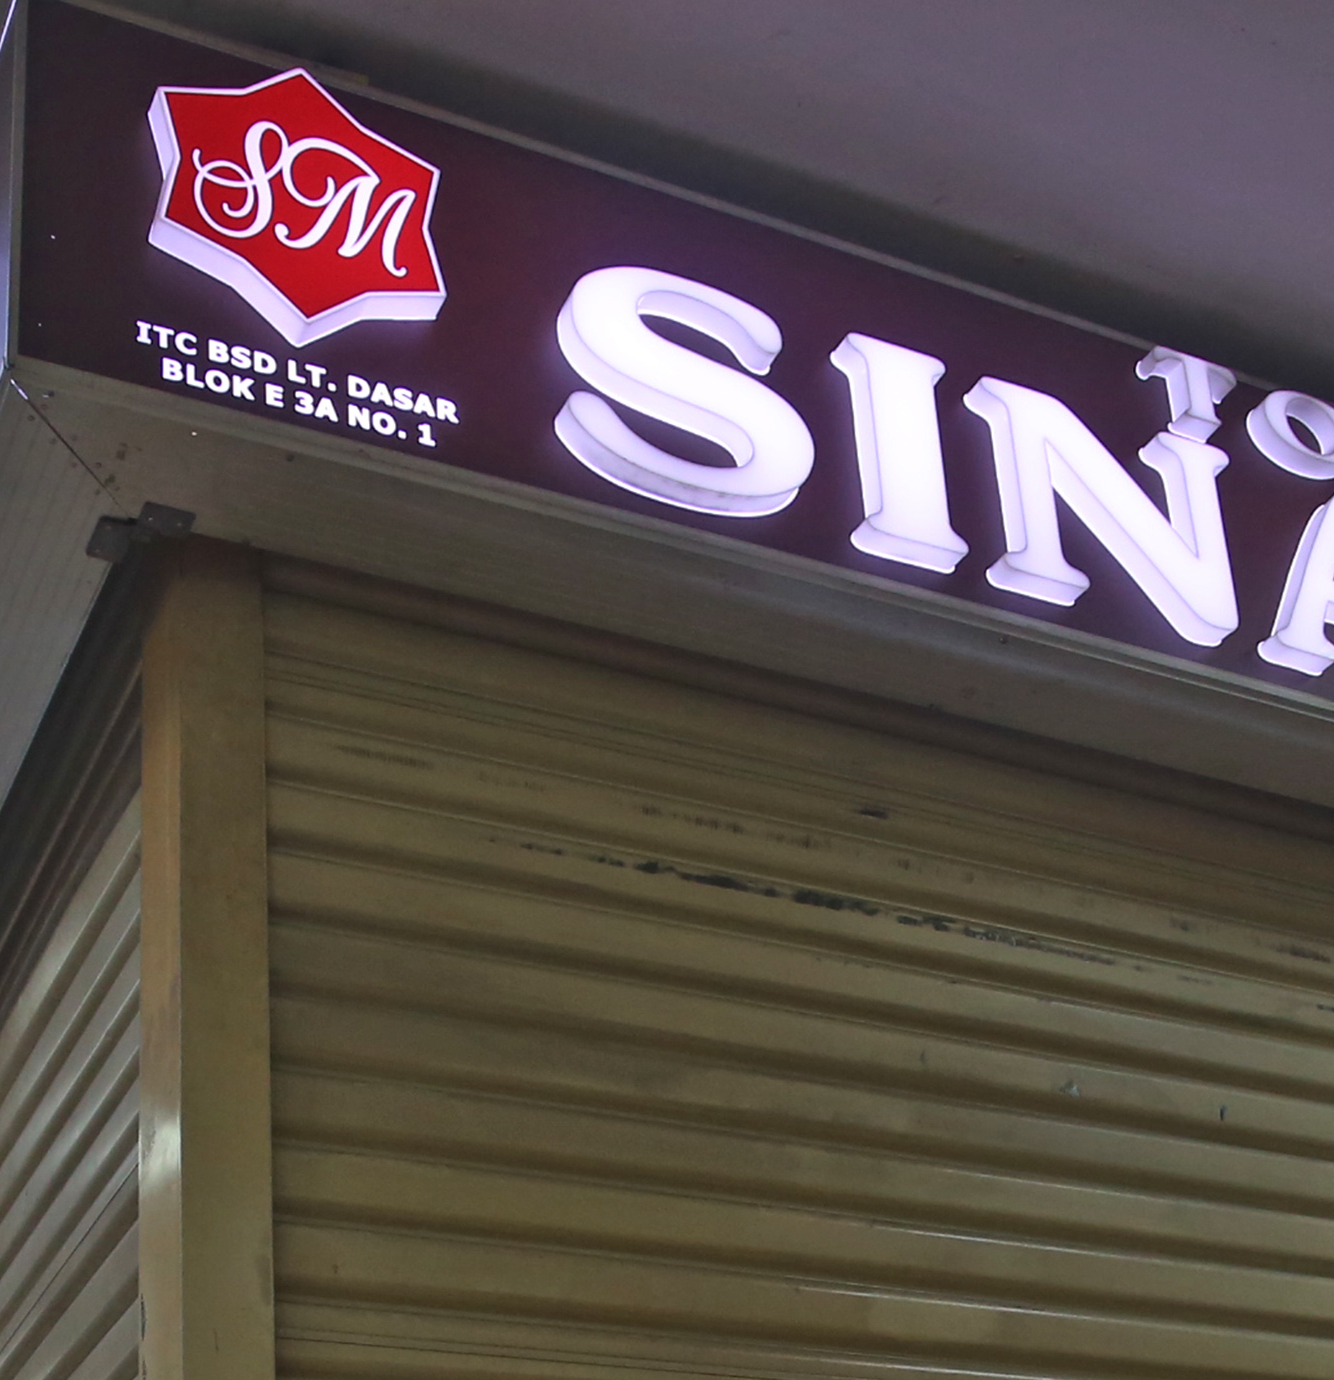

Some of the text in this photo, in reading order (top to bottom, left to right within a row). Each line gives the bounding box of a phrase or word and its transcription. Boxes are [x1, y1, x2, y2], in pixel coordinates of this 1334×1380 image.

[192, 120, 417, 278] SM
[135, 319, 460, 425] ITC BSD LT. DASAR
[161, 356, 437, 448] BLOK E 3A NO. 1
